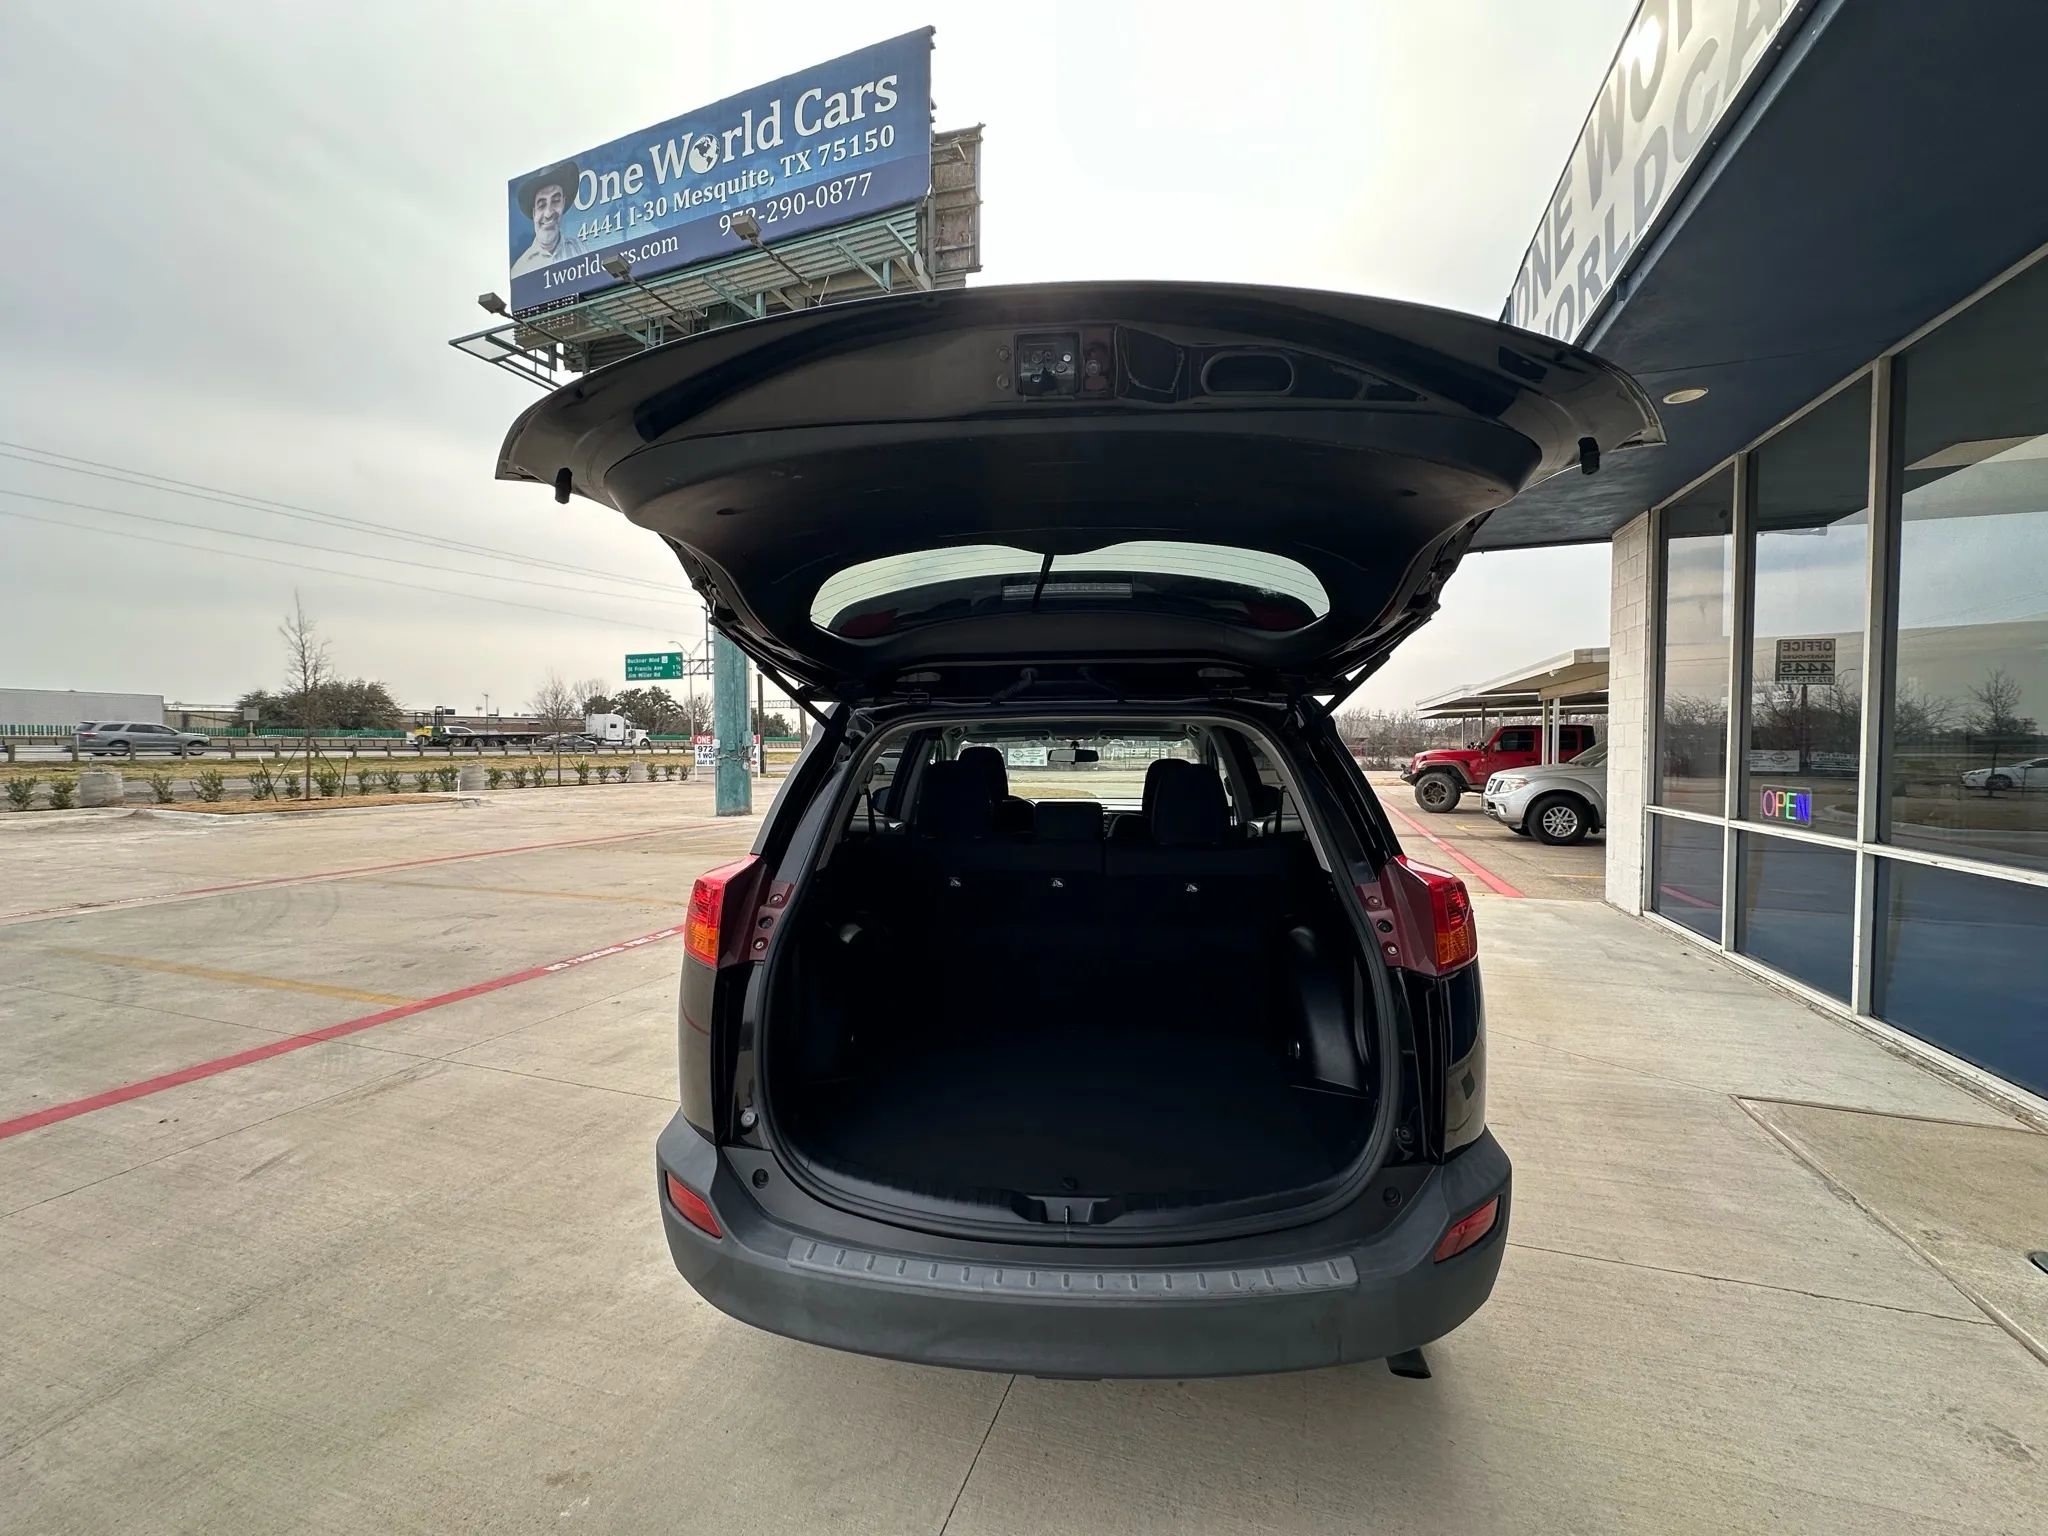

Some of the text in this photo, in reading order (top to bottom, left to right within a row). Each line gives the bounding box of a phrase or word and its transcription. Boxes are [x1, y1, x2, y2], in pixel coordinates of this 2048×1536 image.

[574, 74, 898, 211] One World Cars
[577, 124, 895, 241] 4441 I-30 Mesquite, TX 75150
[543, 235, 679, 289] 1worldrs.com
[1546, 125, 1668, 342] ORLD
[1762, 790, 1809, 822] OPEN
